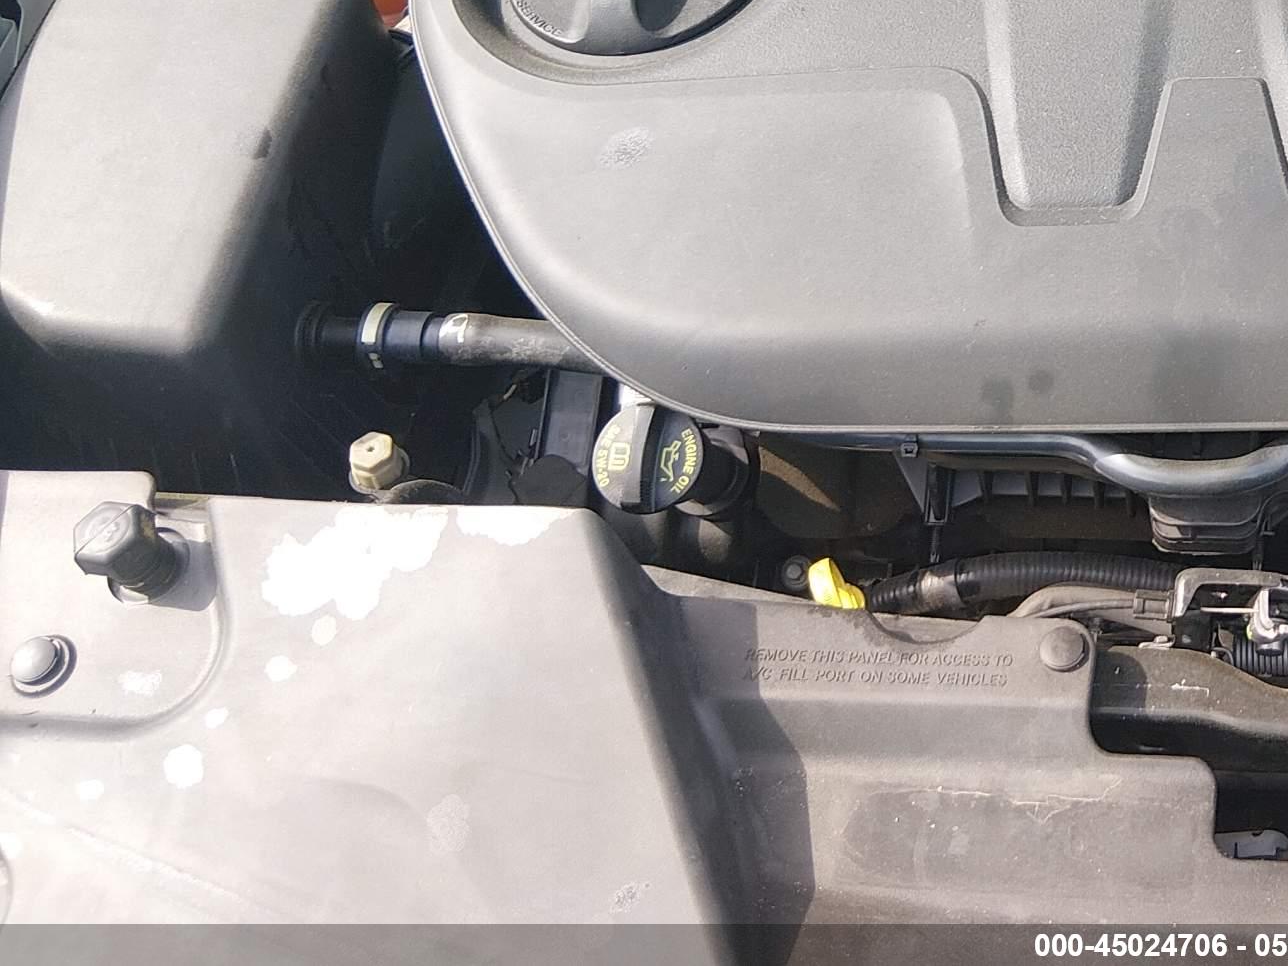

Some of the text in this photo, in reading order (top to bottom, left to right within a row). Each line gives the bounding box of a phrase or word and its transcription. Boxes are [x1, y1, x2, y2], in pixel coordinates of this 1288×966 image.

[517, 0, 562, 35] SERVICE
[595, 449, 611, 488] 5W-20
[670, 428, 698, 494] ENGINE OIL
[744, 648, 1013, 667] REMOVE THIS PANEL FOR ACCESS TO
[779, 667, 808, 682] FILL
[815, 669, 855, 684] PORT
[860, 670, 884, 685] ON
[887, 671, 930, 686] SOME
[936, 672, 1009, 688] VEHICLES
